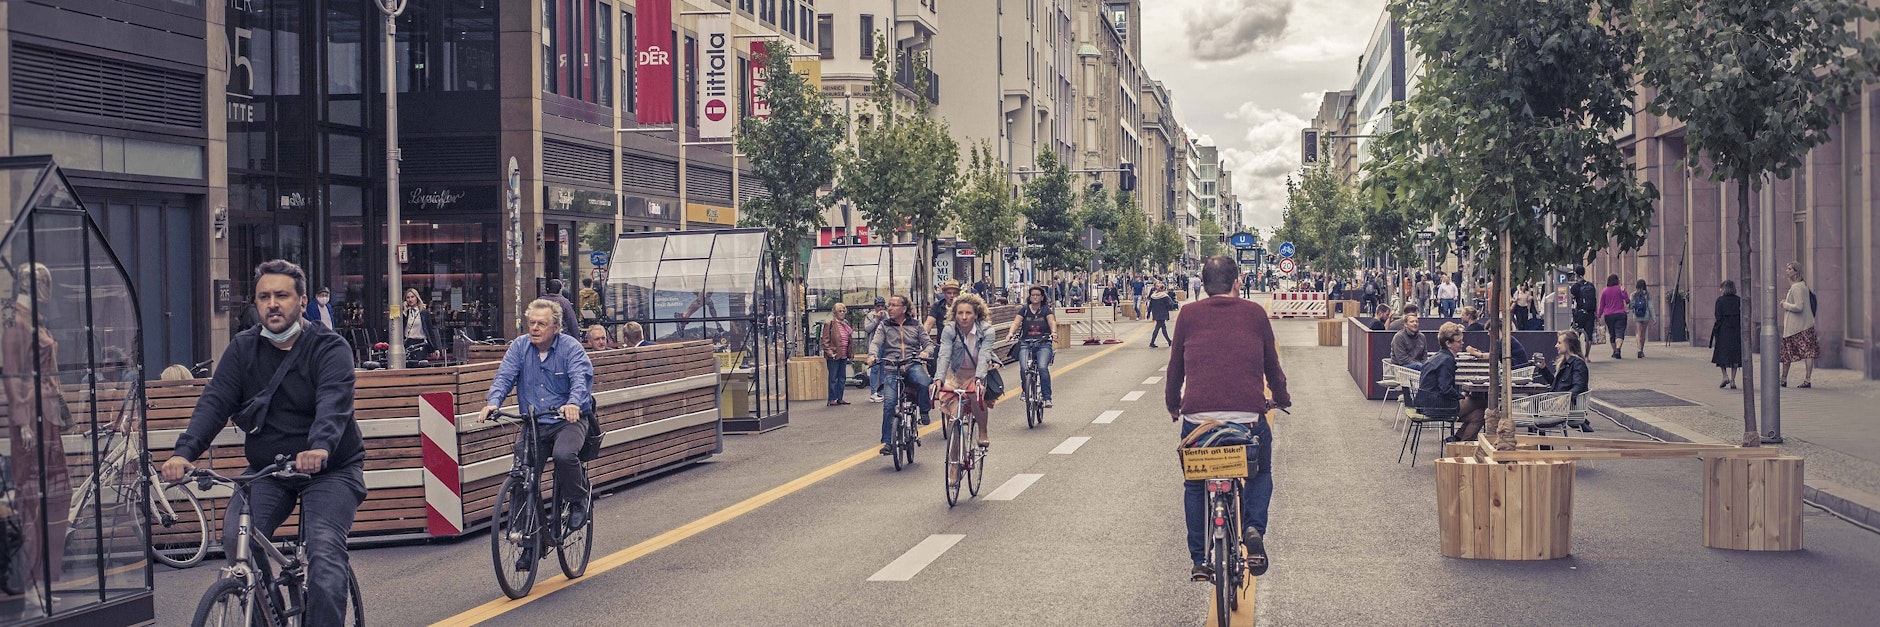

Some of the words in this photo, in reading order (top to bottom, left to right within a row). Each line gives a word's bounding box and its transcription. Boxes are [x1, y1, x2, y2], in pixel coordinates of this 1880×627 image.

[639, 51, 670, 65] DER
[706, 33, 726, 96] iittala
[228, 101, 254, 123] ITTE
[1560, 274, 1566, 283] P
